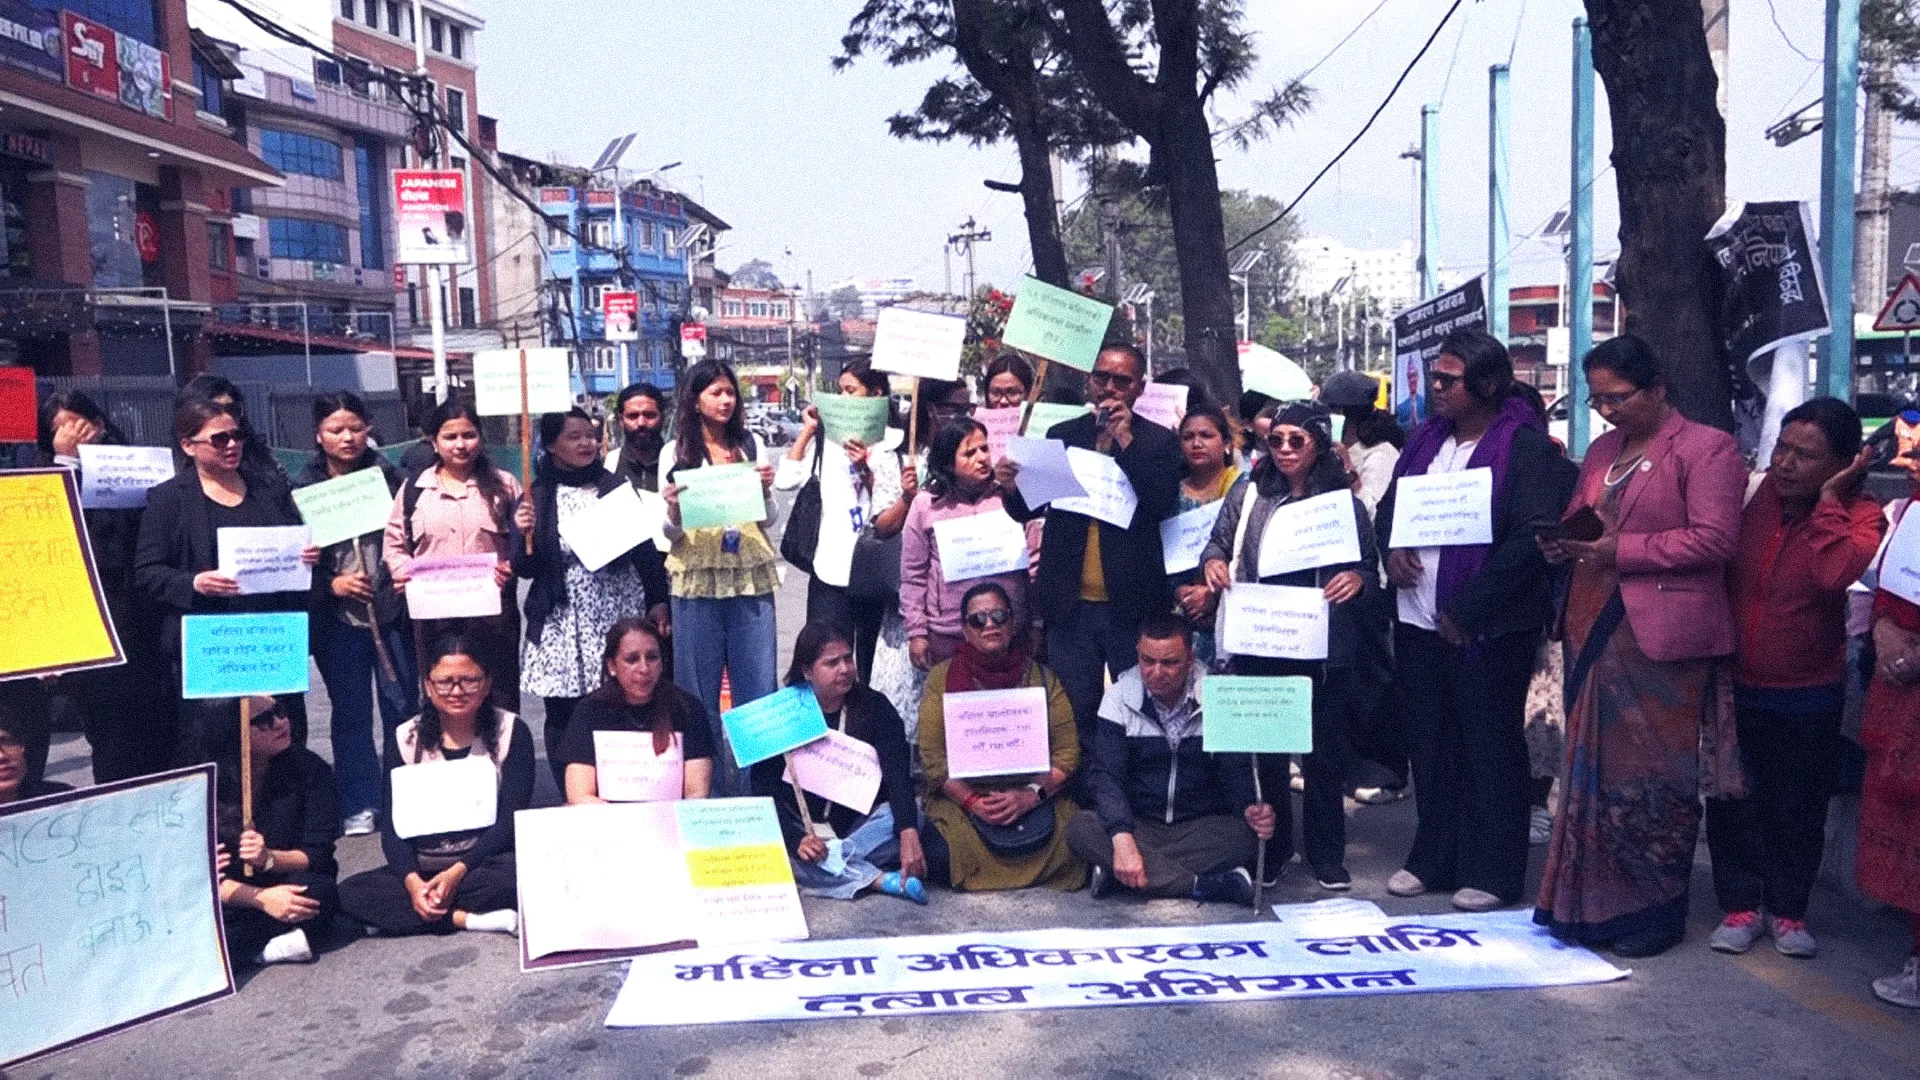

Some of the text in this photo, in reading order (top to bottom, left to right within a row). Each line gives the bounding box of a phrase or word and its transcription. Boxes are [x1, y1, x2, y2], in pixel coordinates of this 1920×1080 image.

[675, 923, 1480, 981] महिला अधिकारका लागि
[798, 968, 1416, 1016] दबाब अभियान
